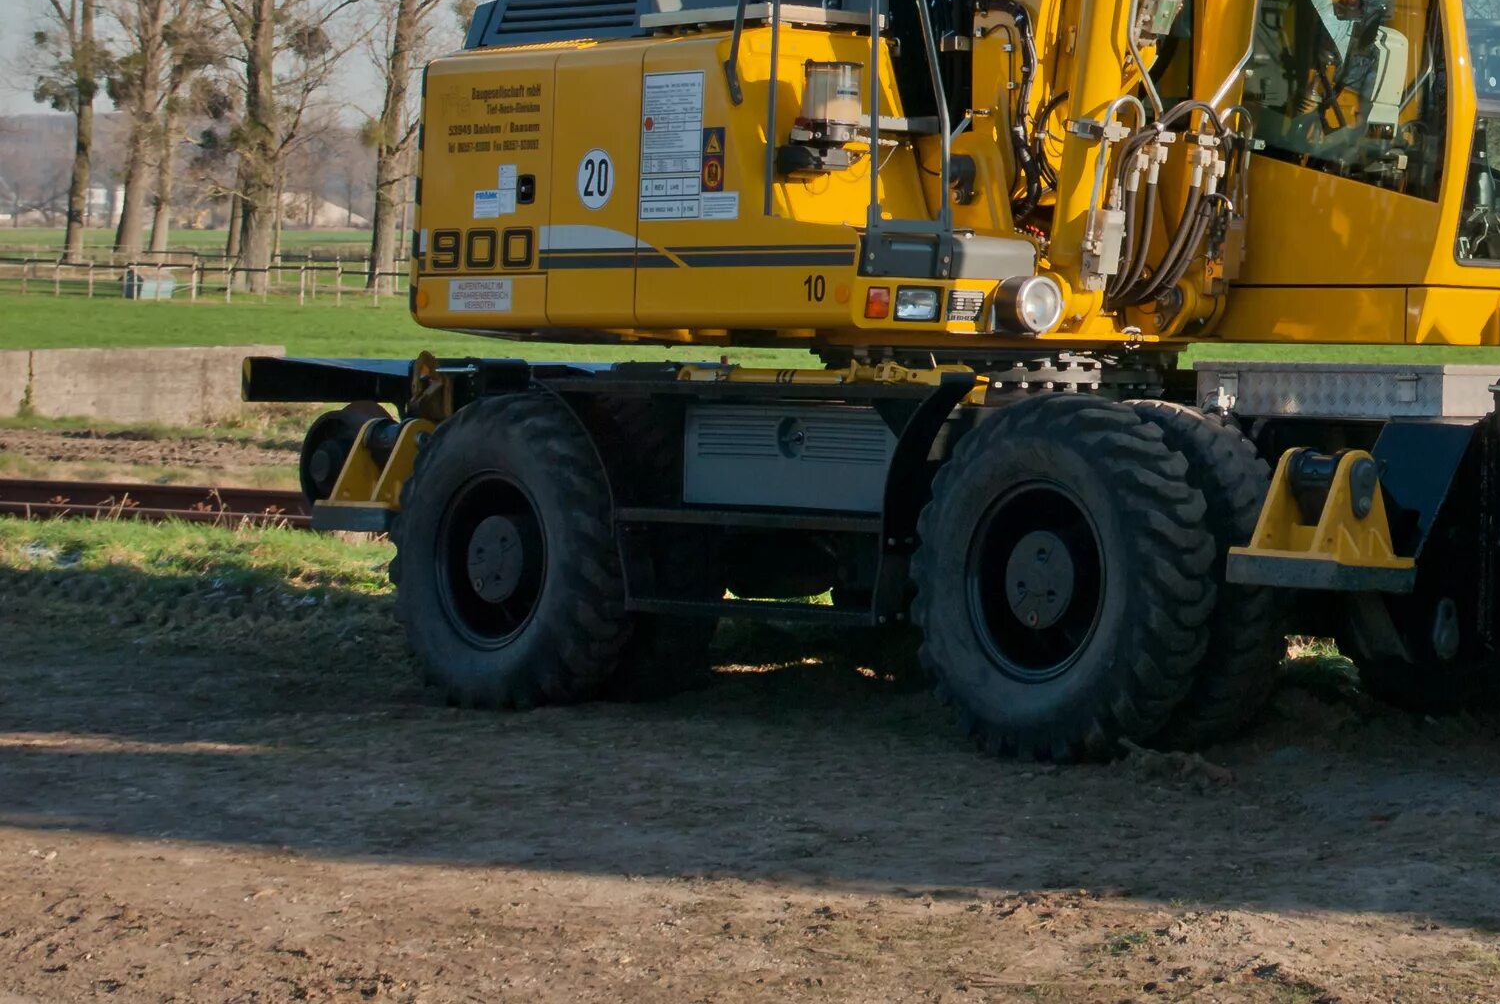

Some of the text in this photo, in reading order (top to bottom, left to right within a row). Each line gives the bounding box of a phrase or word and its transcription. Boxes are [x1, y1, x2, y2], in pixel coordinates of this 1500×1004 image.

[584, 159, 609, 197] 20
[431, 227, 534, 270] 900
[464, 300, 496, 309] VERBOTEN
[803, 274, 826, 302] 10
